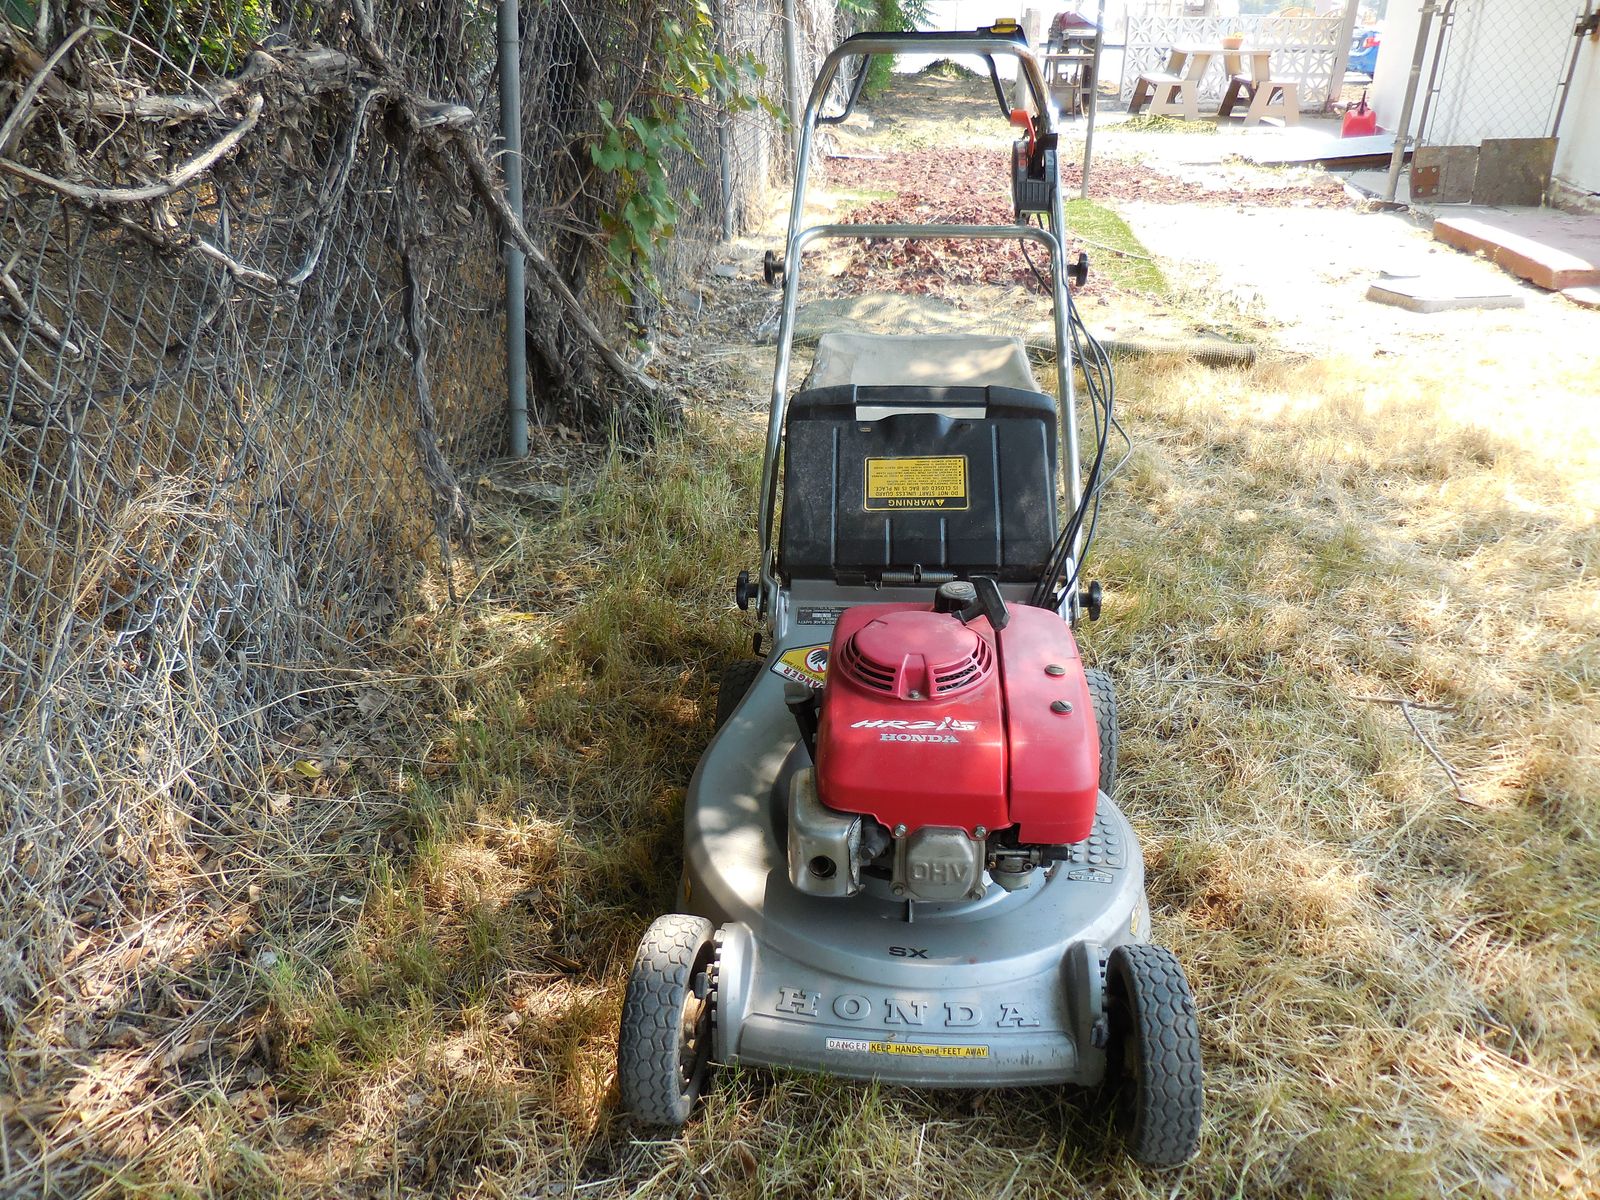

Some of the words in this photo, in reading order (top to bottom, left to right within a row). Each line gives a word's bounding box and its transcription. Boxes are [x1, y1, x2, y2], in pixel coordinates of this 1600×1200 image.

[888, 499, 935, 507] WARNING
[783, 666, 823, 688] ANGER
[879, 733, 959, 743] HONDA
[912, 862, 968, 881] OHV
[888, 946, 928, 959] SX
[775, 987, 1040, 1028] HONDA
[829, 1040, 867, 1050] DANGER
[871, 1043, 892, 1053] KEEP
[895, 1045, 922, 1054] HANDS
[925, 1047, 940, 1055] and
[943, 1047, 961, 1055] FEET
[965, 1048, 987, 1056] AWAY
